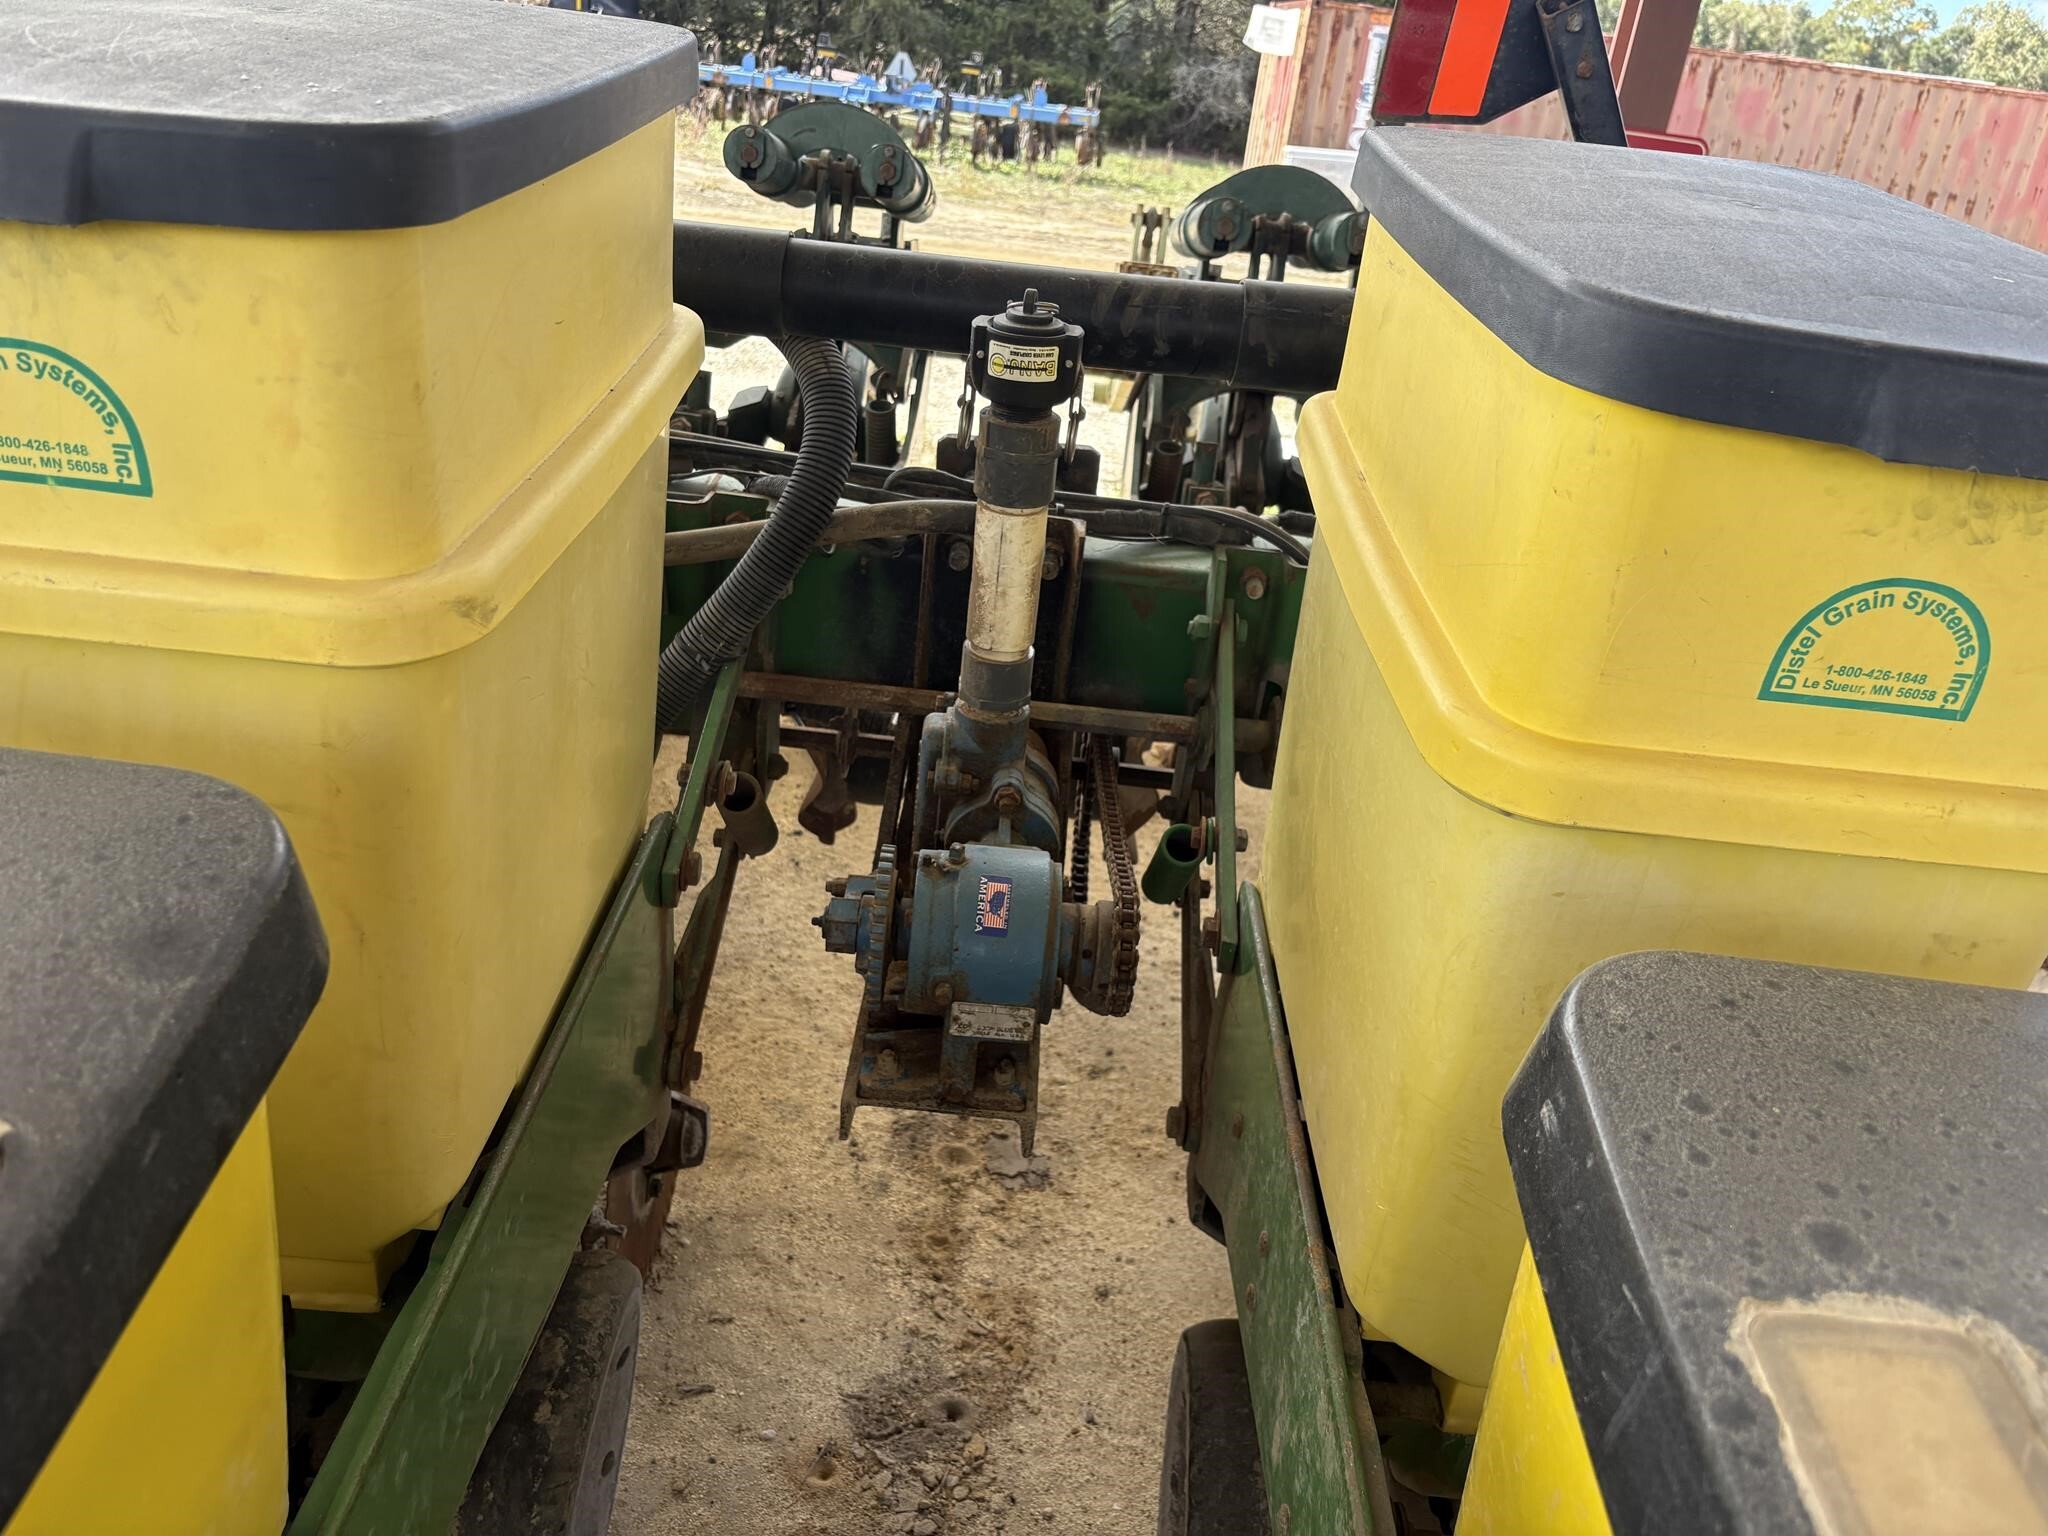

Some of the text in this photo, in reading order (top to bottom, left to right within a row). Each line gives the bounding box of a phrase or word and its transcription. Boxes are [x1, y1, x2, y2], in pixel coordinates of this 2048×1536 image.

[16, 352, 133, 484] Systems, Inc.
[0, 454, 109, 475] ueur, MN 56058
[1774, 590, 1976, 709] Distel Grain Systems, Inc.
[1802, 677, 1937, 702] Le Sueur, MN 56058
[1826, 664, 1928, 685] 1-800-426-1848
[974, 876, 989, 932] AMERICA
